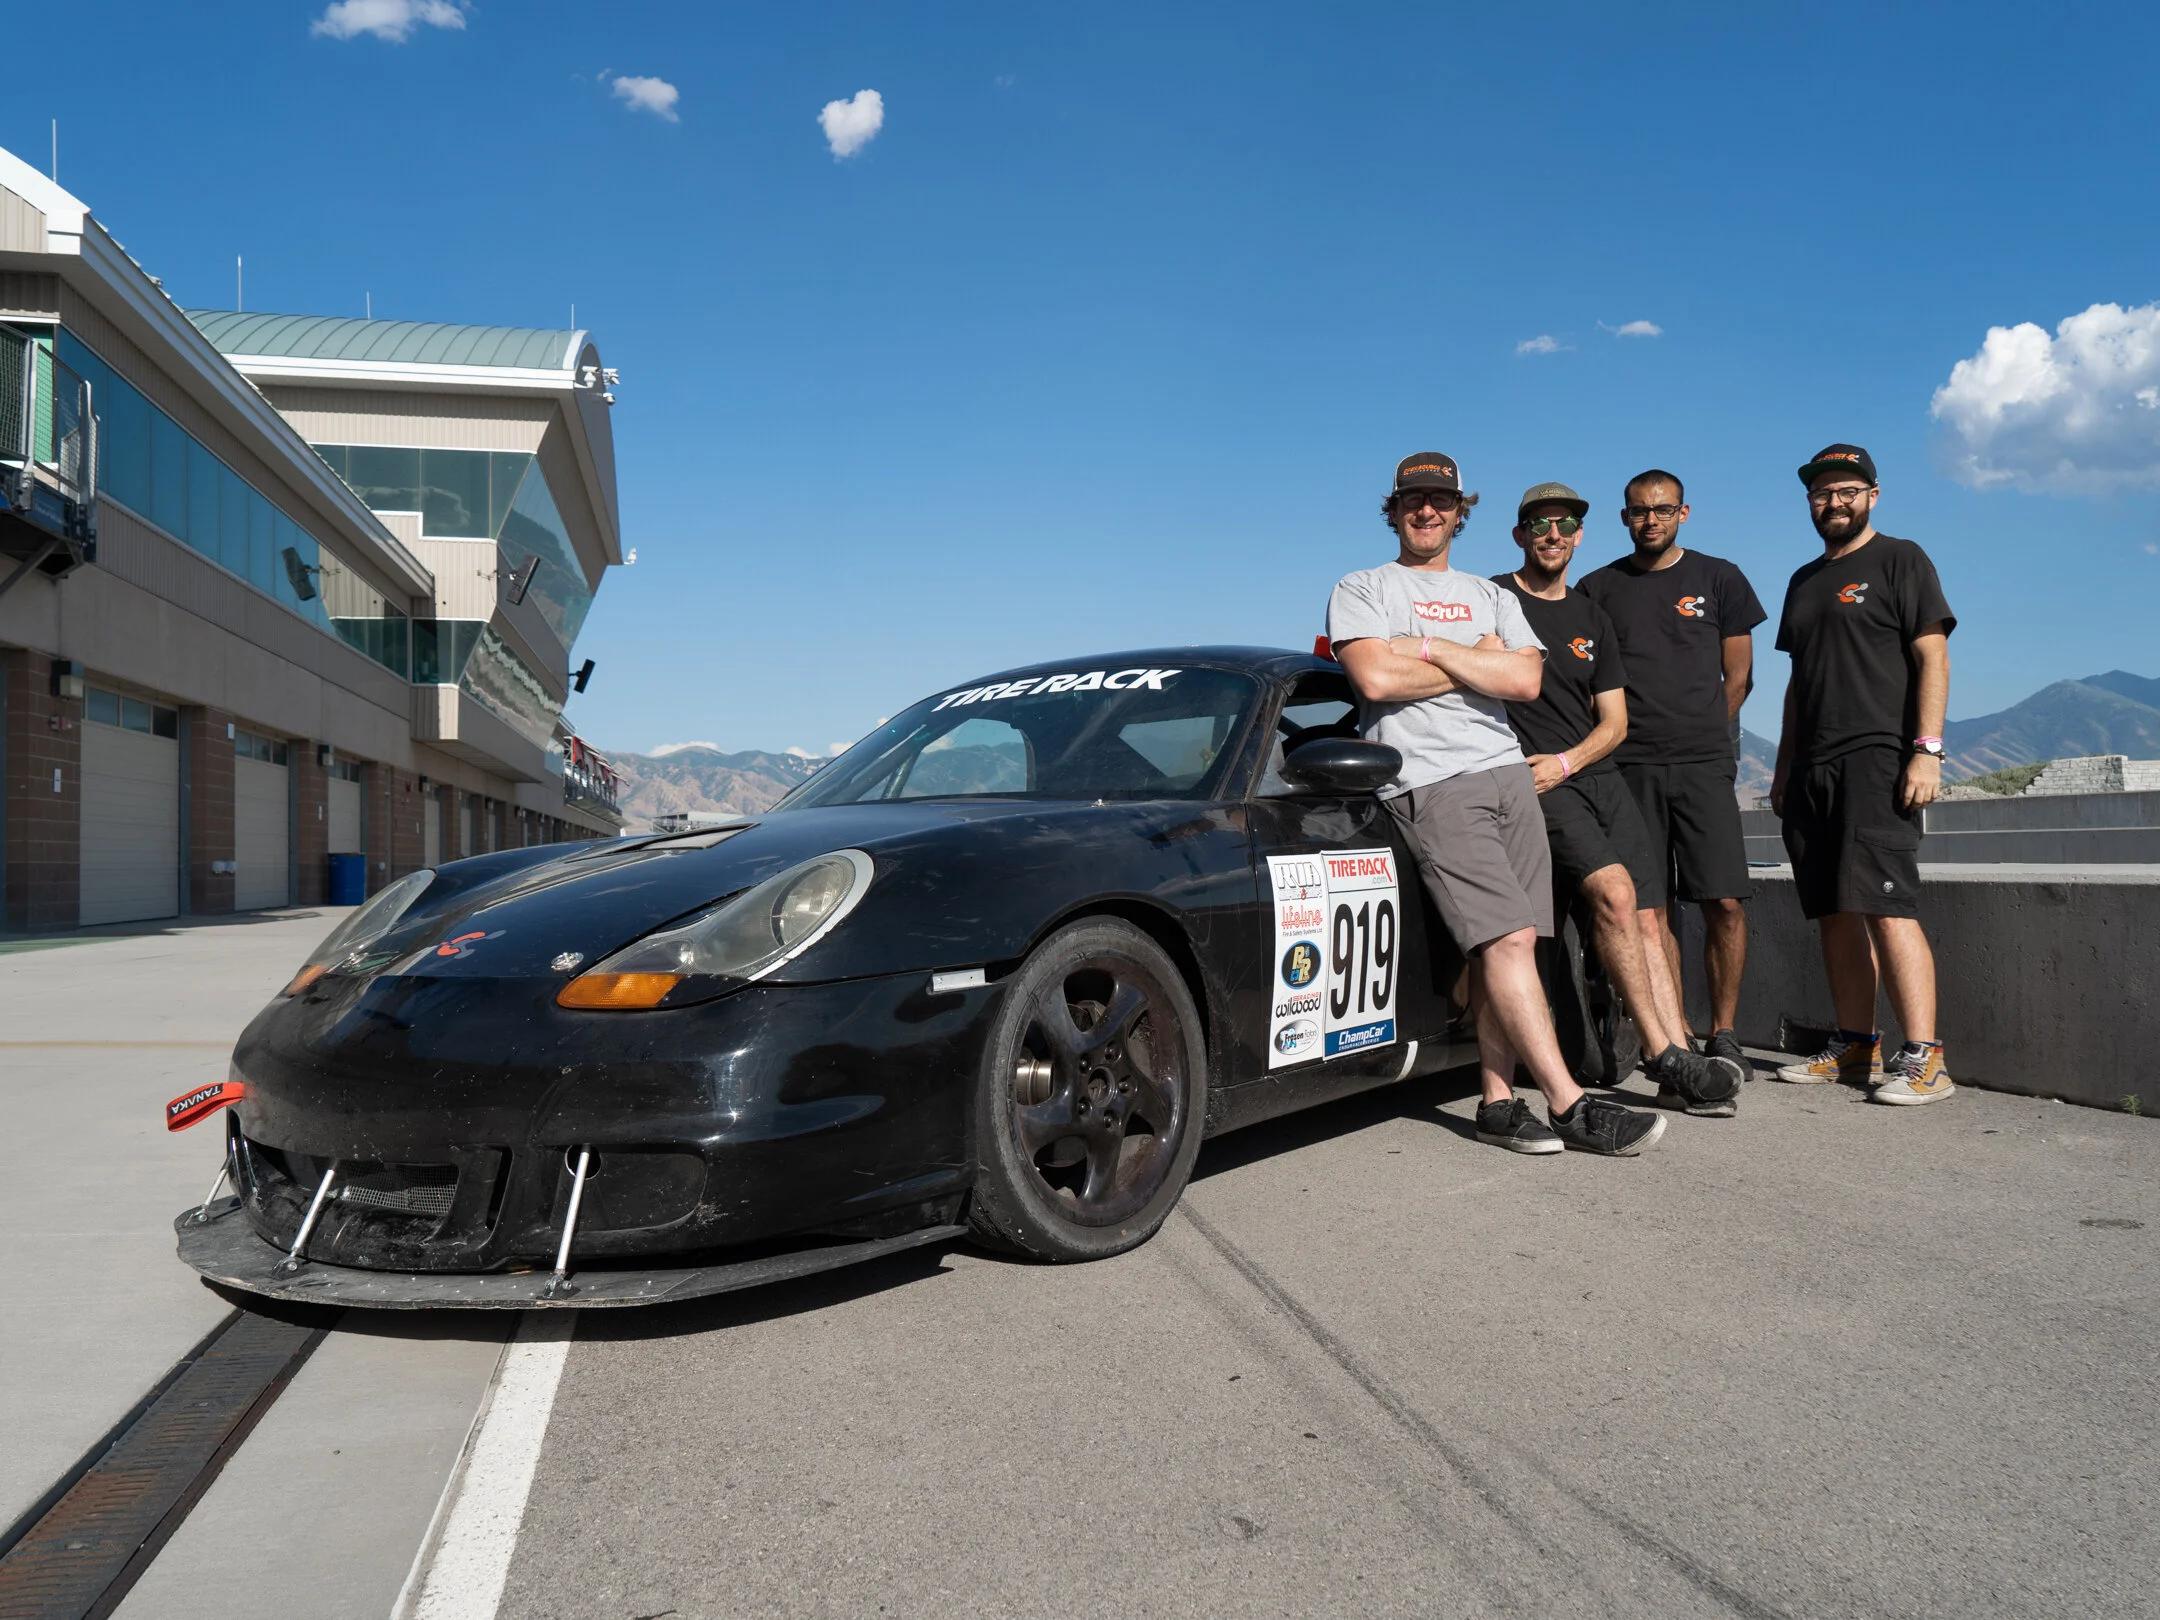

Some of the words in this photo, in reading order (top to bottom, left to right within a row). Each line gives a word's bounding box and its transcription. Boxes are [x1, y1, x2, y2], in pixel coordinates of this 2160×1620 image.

[1414, 603, 1469, 620] MOTUL
[930, 676, 1042, 713] TIRE
[1028, 668, 1183, 695] RACK
[1328, 858, 1357, 878] TIRE
[1357, 857, 1393, 883] RACK
[1281, 904, 1323, 930] lifeline
[1330, 899, 1395, 1020] 919
[1275, 991, 1322, 1018] wilwood
[1338, 1026, 1385, 1046] ChampCar
[171, 1085, 221, 1114] TANAKA
